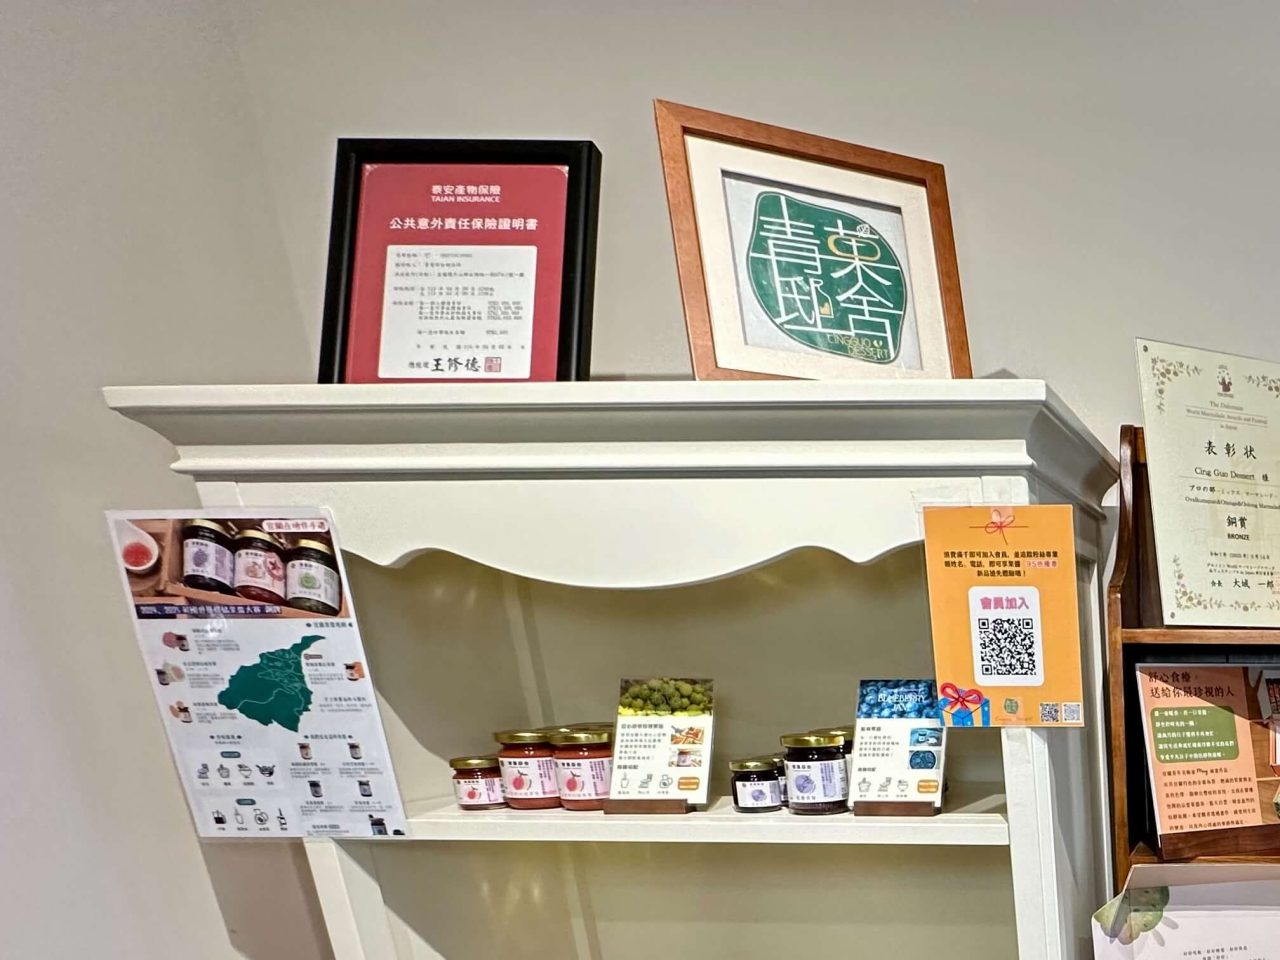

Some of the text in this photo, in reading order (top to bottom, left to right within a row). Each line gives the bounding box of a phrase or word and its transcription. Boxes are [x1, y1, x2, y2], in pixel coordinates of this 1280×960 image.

[431, 185, 501, 195] 泰安產物保險
[389, 217, 538, 231] 公共意外責任保險證明書
[1194, 467, 1211, 477] Cing
[1213, 469, 1228, 478] Guo
[1227, 532, 1250, 541] BRONZE
[980, 597, 1030, 610] 會員加入
[878, 694, 926, 703] BLUEBERRY
